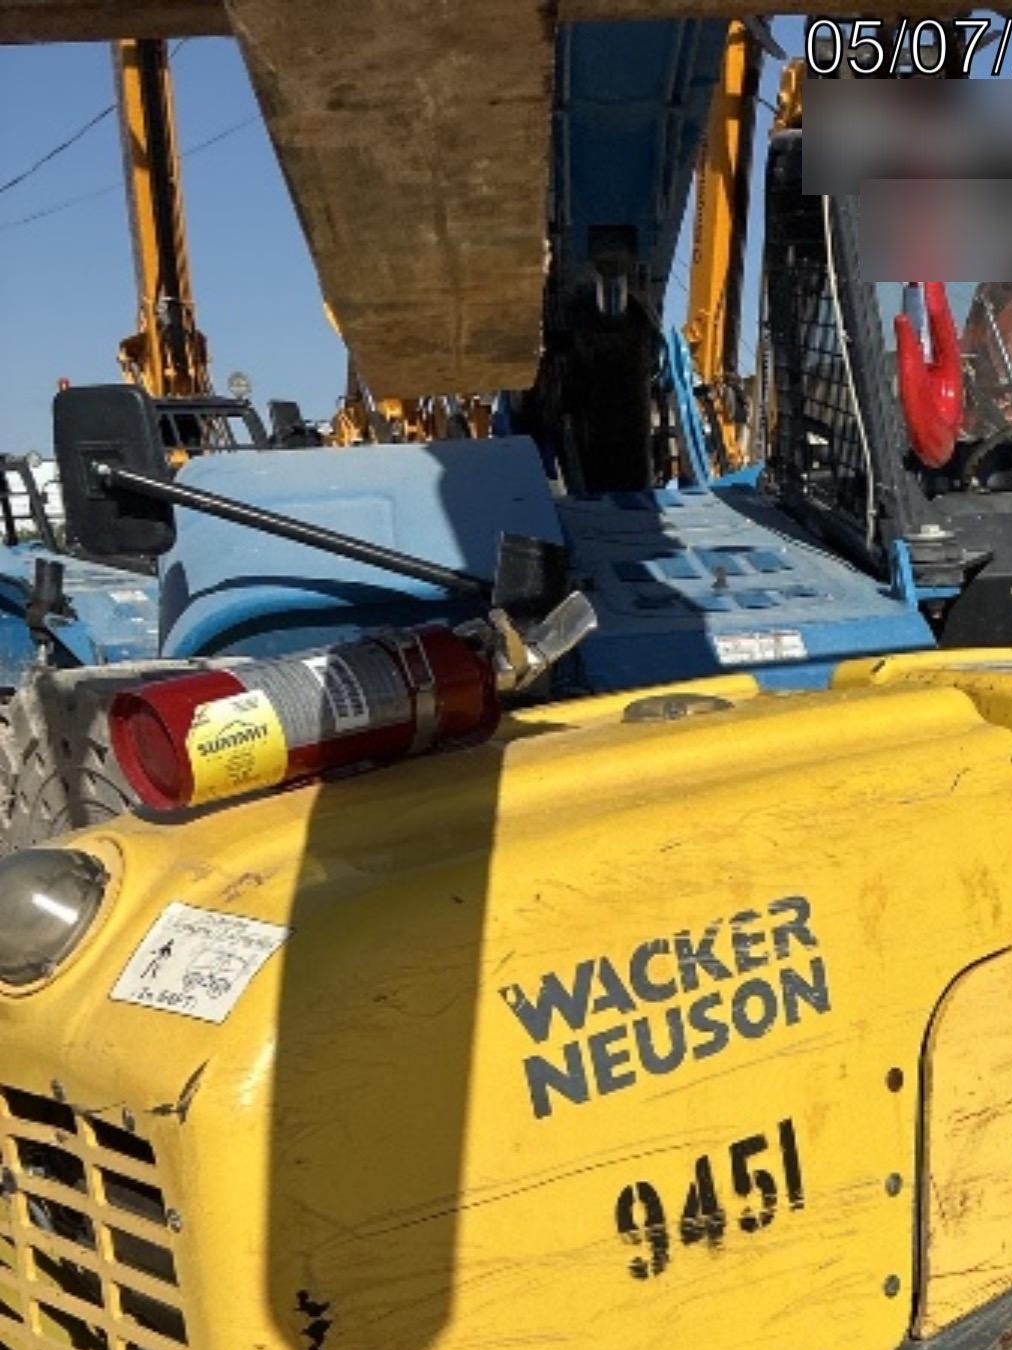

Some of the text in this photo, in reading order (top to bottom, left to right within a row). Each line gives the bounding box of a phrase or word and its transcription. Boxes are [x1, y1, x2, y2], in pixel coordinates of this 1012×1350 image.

[499, 896, 818, 1044] WACKER
[522, 956, 831, 1119] NEUSON
[614, 1117, 804, 1280] 9451
